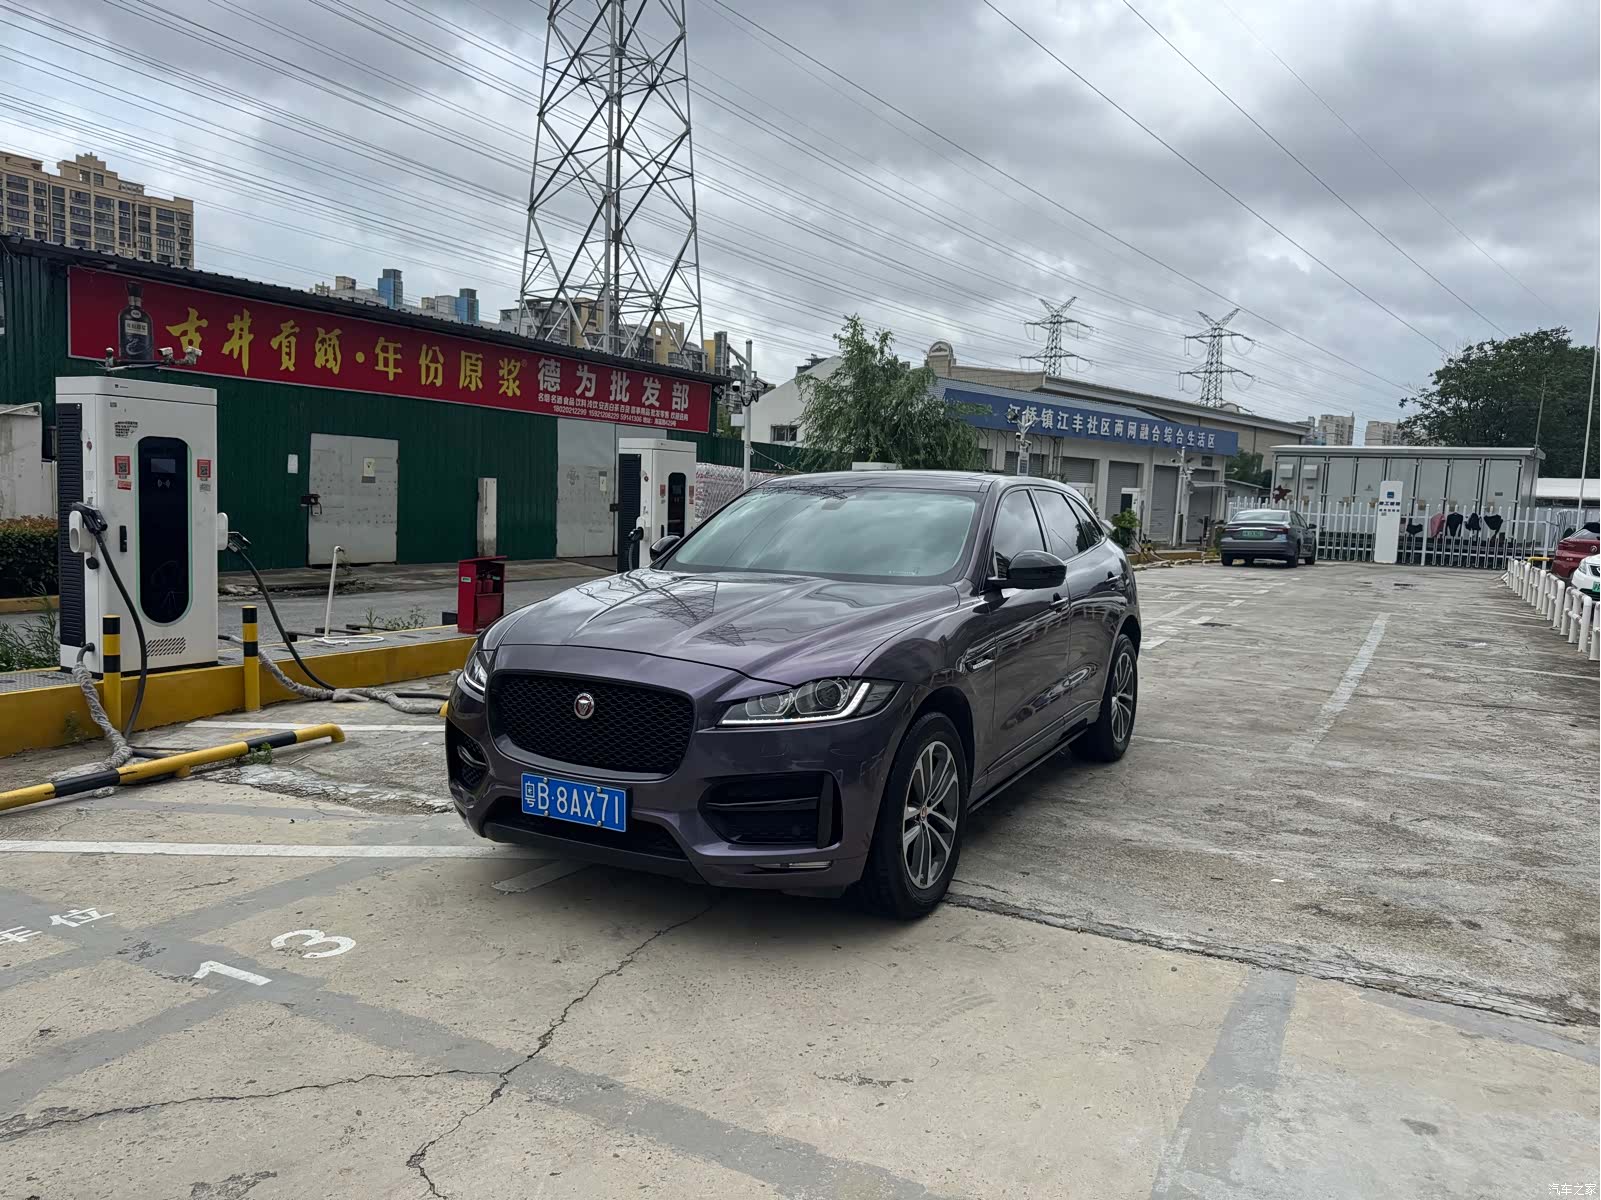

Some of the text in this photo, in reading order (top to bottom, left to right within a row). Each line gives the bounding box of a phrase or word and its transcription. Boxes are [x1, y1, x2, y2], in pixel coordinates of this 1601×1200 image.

[538, 357, 689, 411] 德为批发部
[1007, 403, 1216, 448] 江桥镇江丰社区两网融合综合生活区
